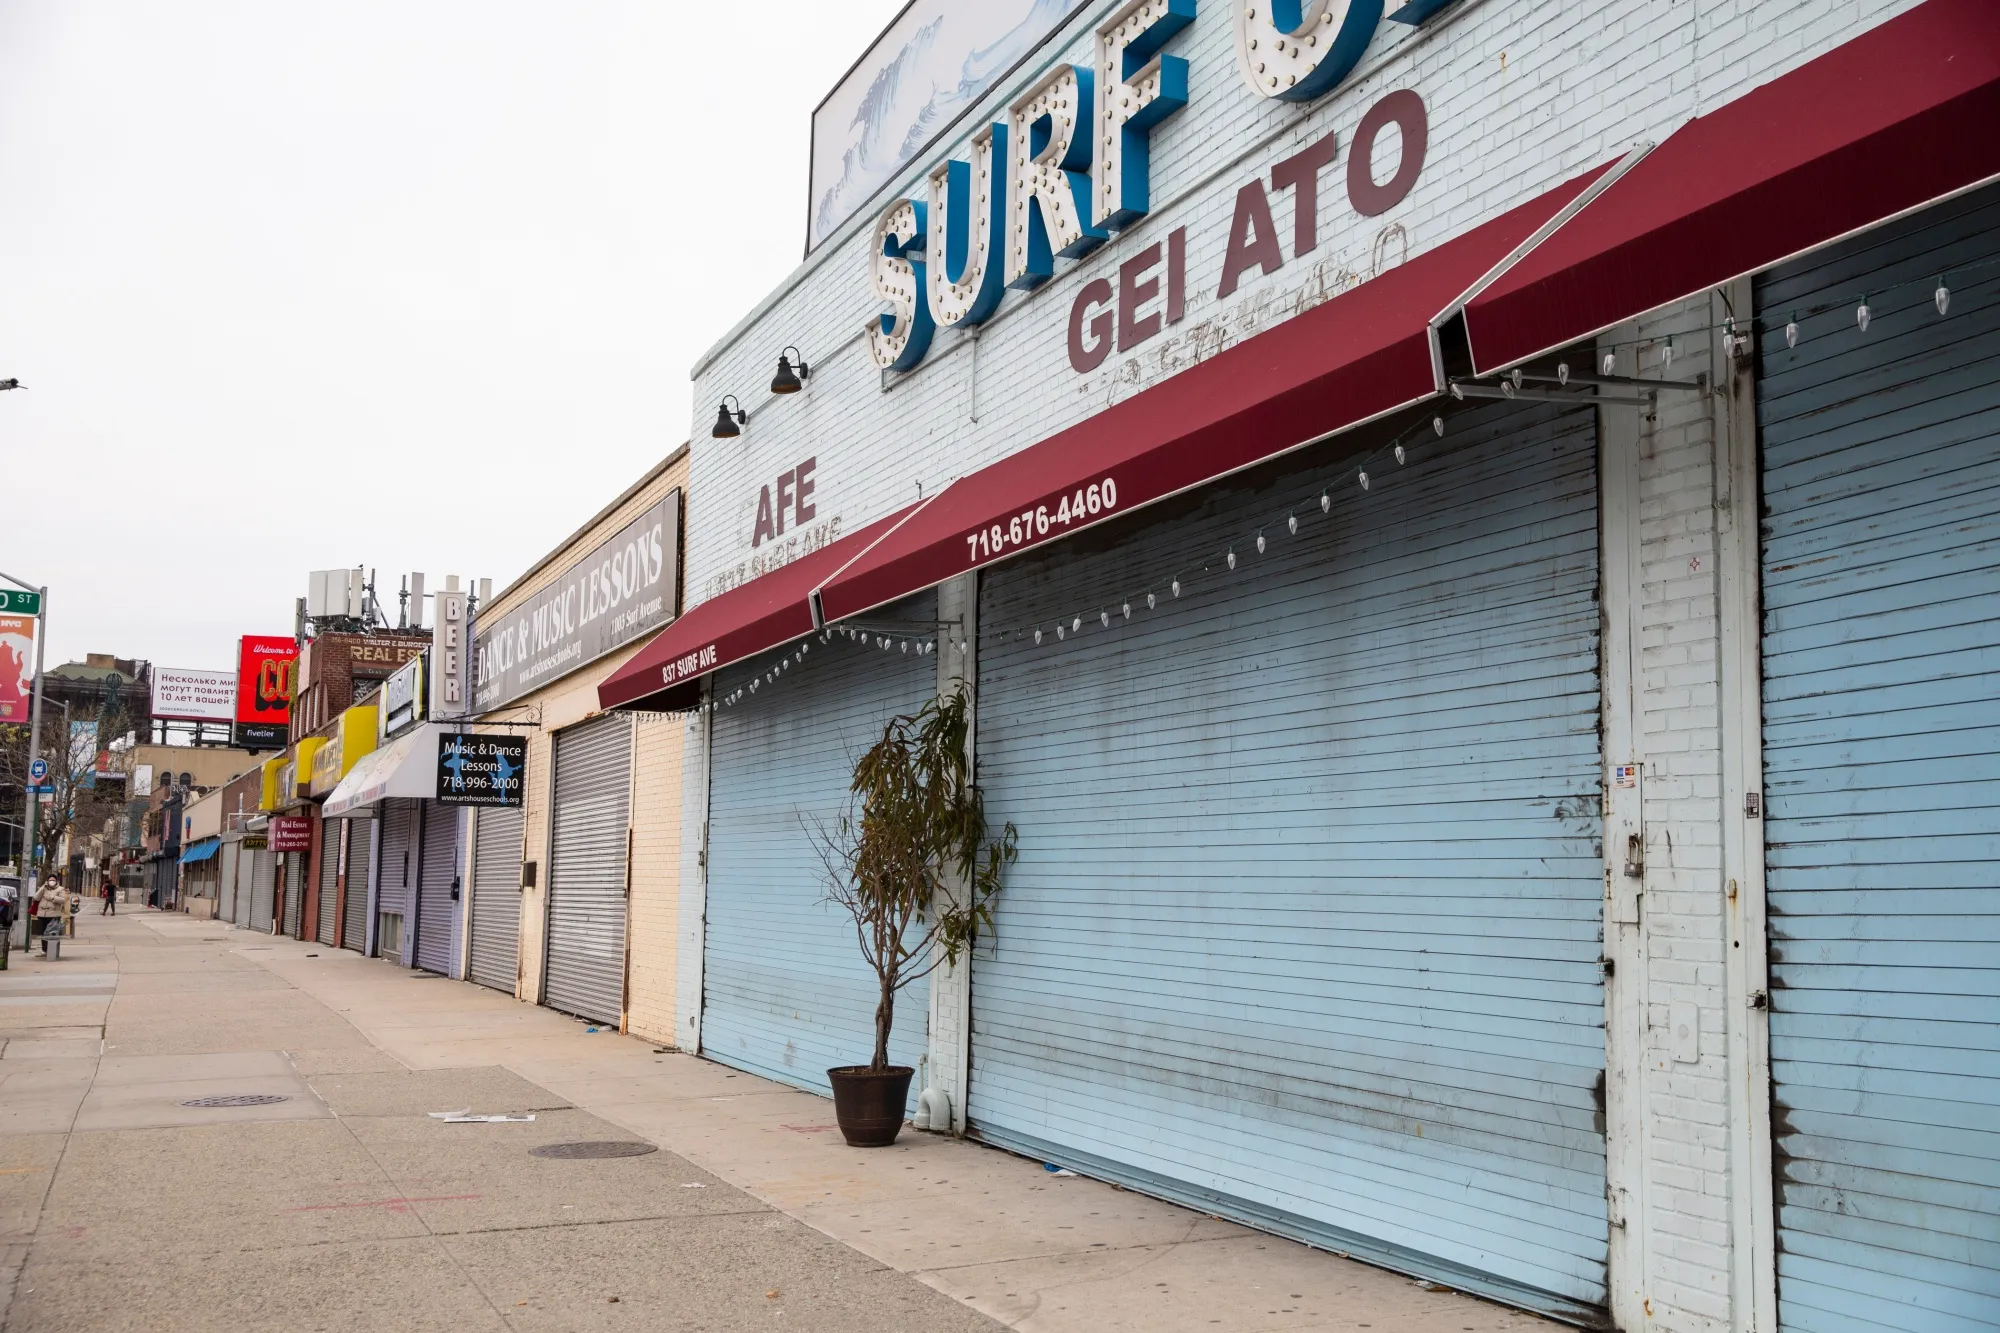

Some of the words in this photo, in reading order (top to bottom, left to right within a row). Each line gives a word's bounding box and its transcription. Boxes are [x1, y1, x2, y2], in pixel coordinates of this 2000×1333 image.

[865, 0, 1196, 372] SURF
[752, 455, 816, 548] AFE
[966, 477, 1117, 562] 718-676-4460
[17, 594, 33, 604] ST
[478, 623, 514, 687] DANCE
[517, 618, 529, 663] &
[531, 583, 576, 654] MUSIC
[579, 523, 662, 628] LESSONS
[626, 603, 639, 627] Surf
[639, 596, 662, 621] Avenue
[253, 643, 285, 655] Welcome
[350, 645, 393, 662] REAL
[445, 596, 461, 702] BEER
[662, 662, 676, 684] 837
[676, 652, 698, 678] SURF
[699, 644, 717, 669] AVE
[161, 673, 217, 686] Несколько
[160, 685, 192, 694] могут
[160, 692, 172, 701] 10
[174, 695, 193, 703] лет
[195, 696, 229, 705] вашей
[444, 742, 476, 755] Music
[478, 743, 487, 755] &
[489, 743, 521, 756] Dance
[461, 759, 503, 772] Lessons
[443, 776, 519, 789] 718-996-2000
[441, 795, 520, 805] www.artshouseschools.org
